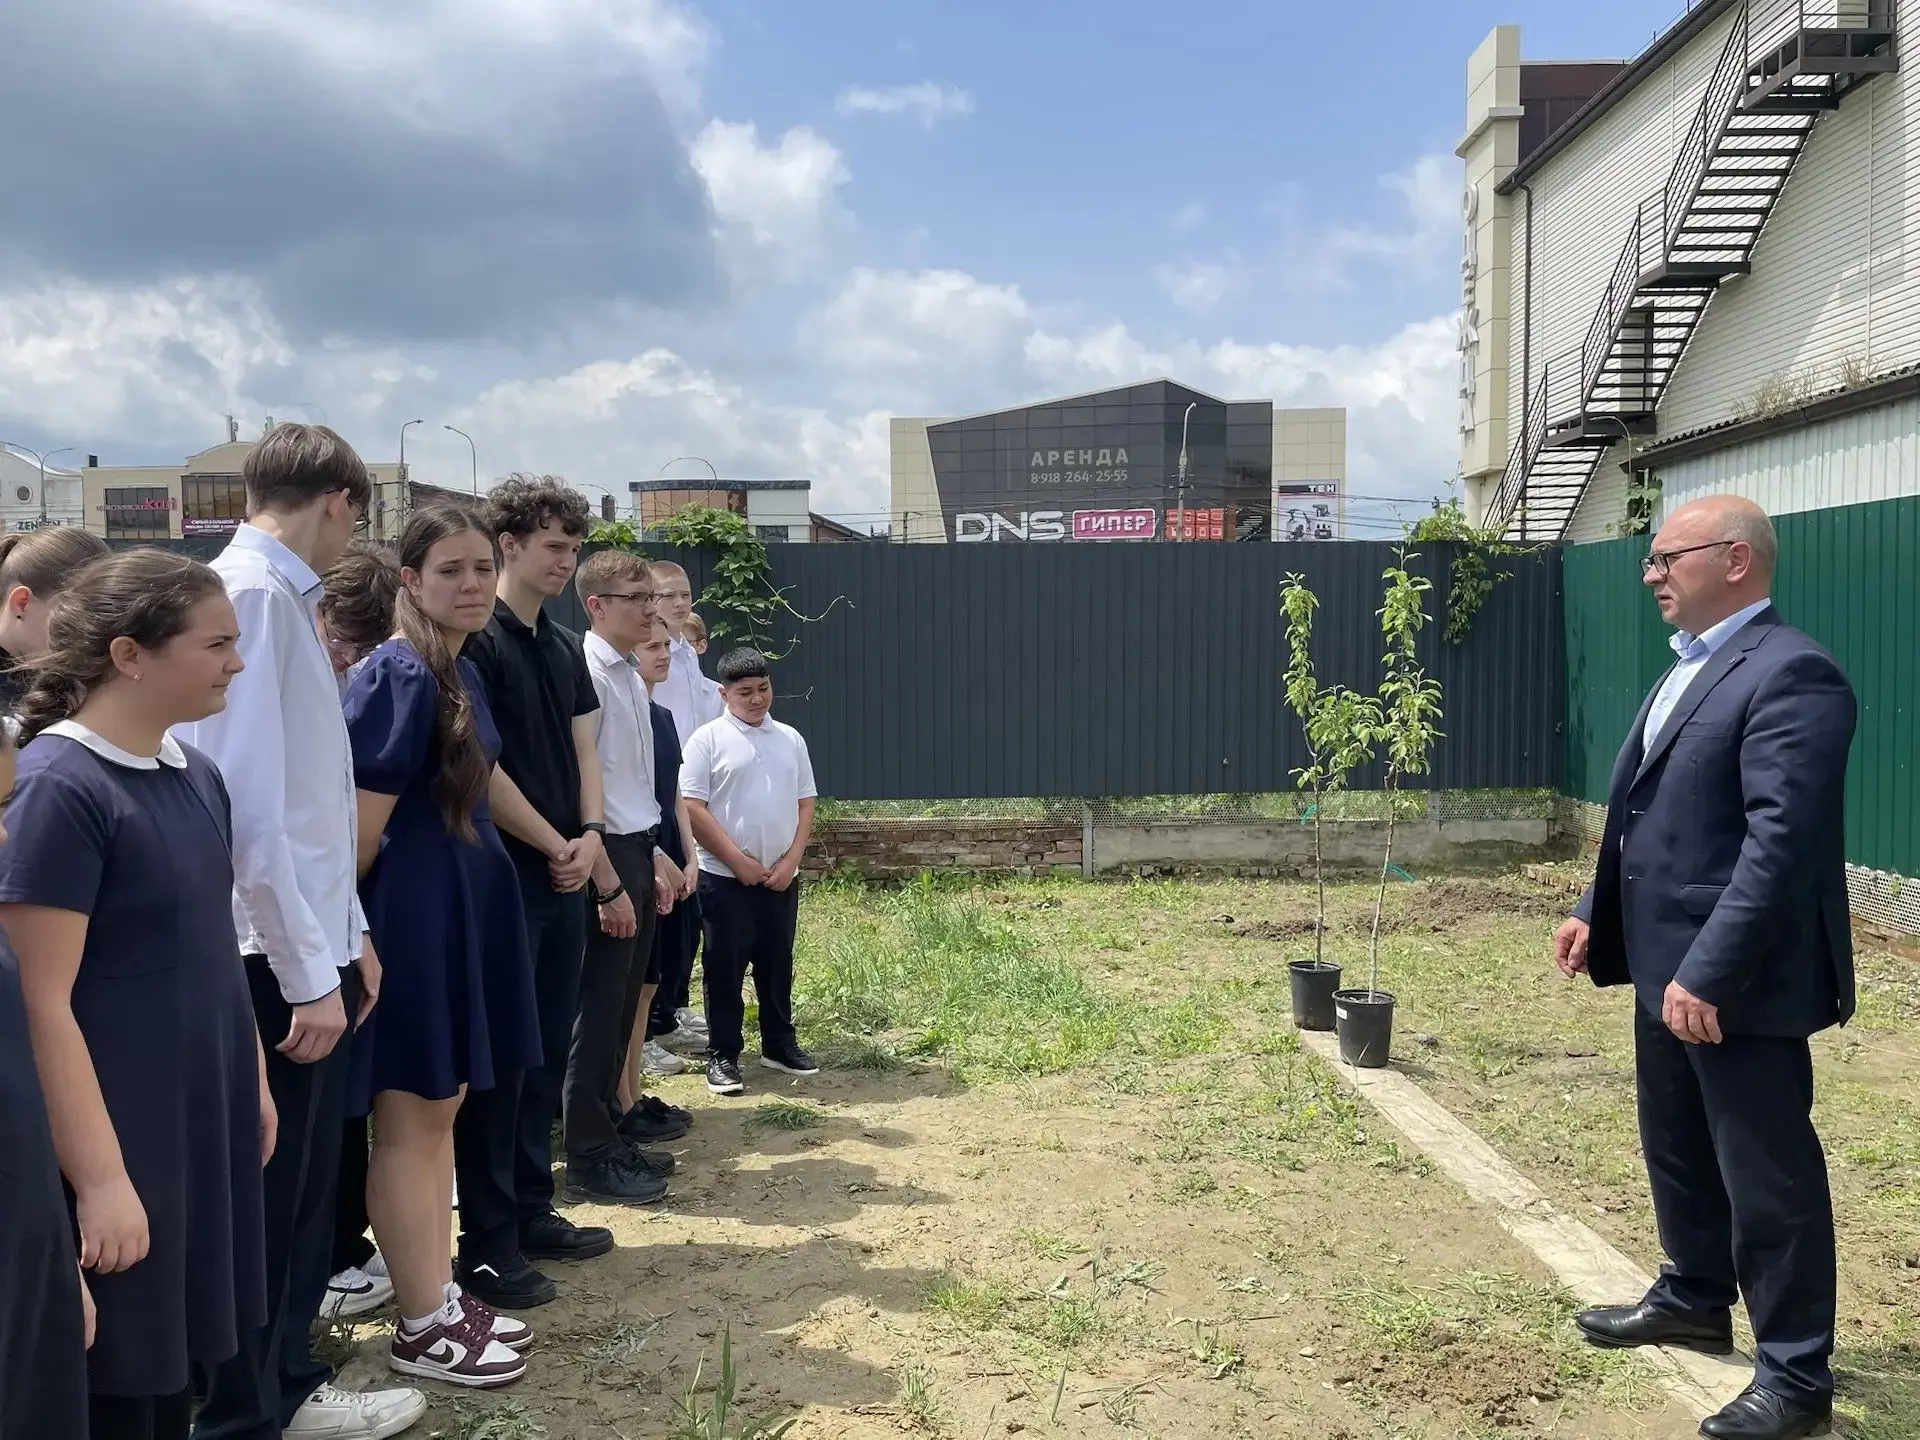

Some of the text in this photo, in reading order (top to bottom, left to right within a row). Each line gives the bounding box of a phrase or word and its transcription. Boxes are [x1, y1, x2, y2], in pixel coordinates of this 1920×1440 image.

[1031, 448, 1129, 467] АРЕНДА
[956, 511, 1065, 543] DNS
[1080, 515, 1147, 532] ГИПЕР
